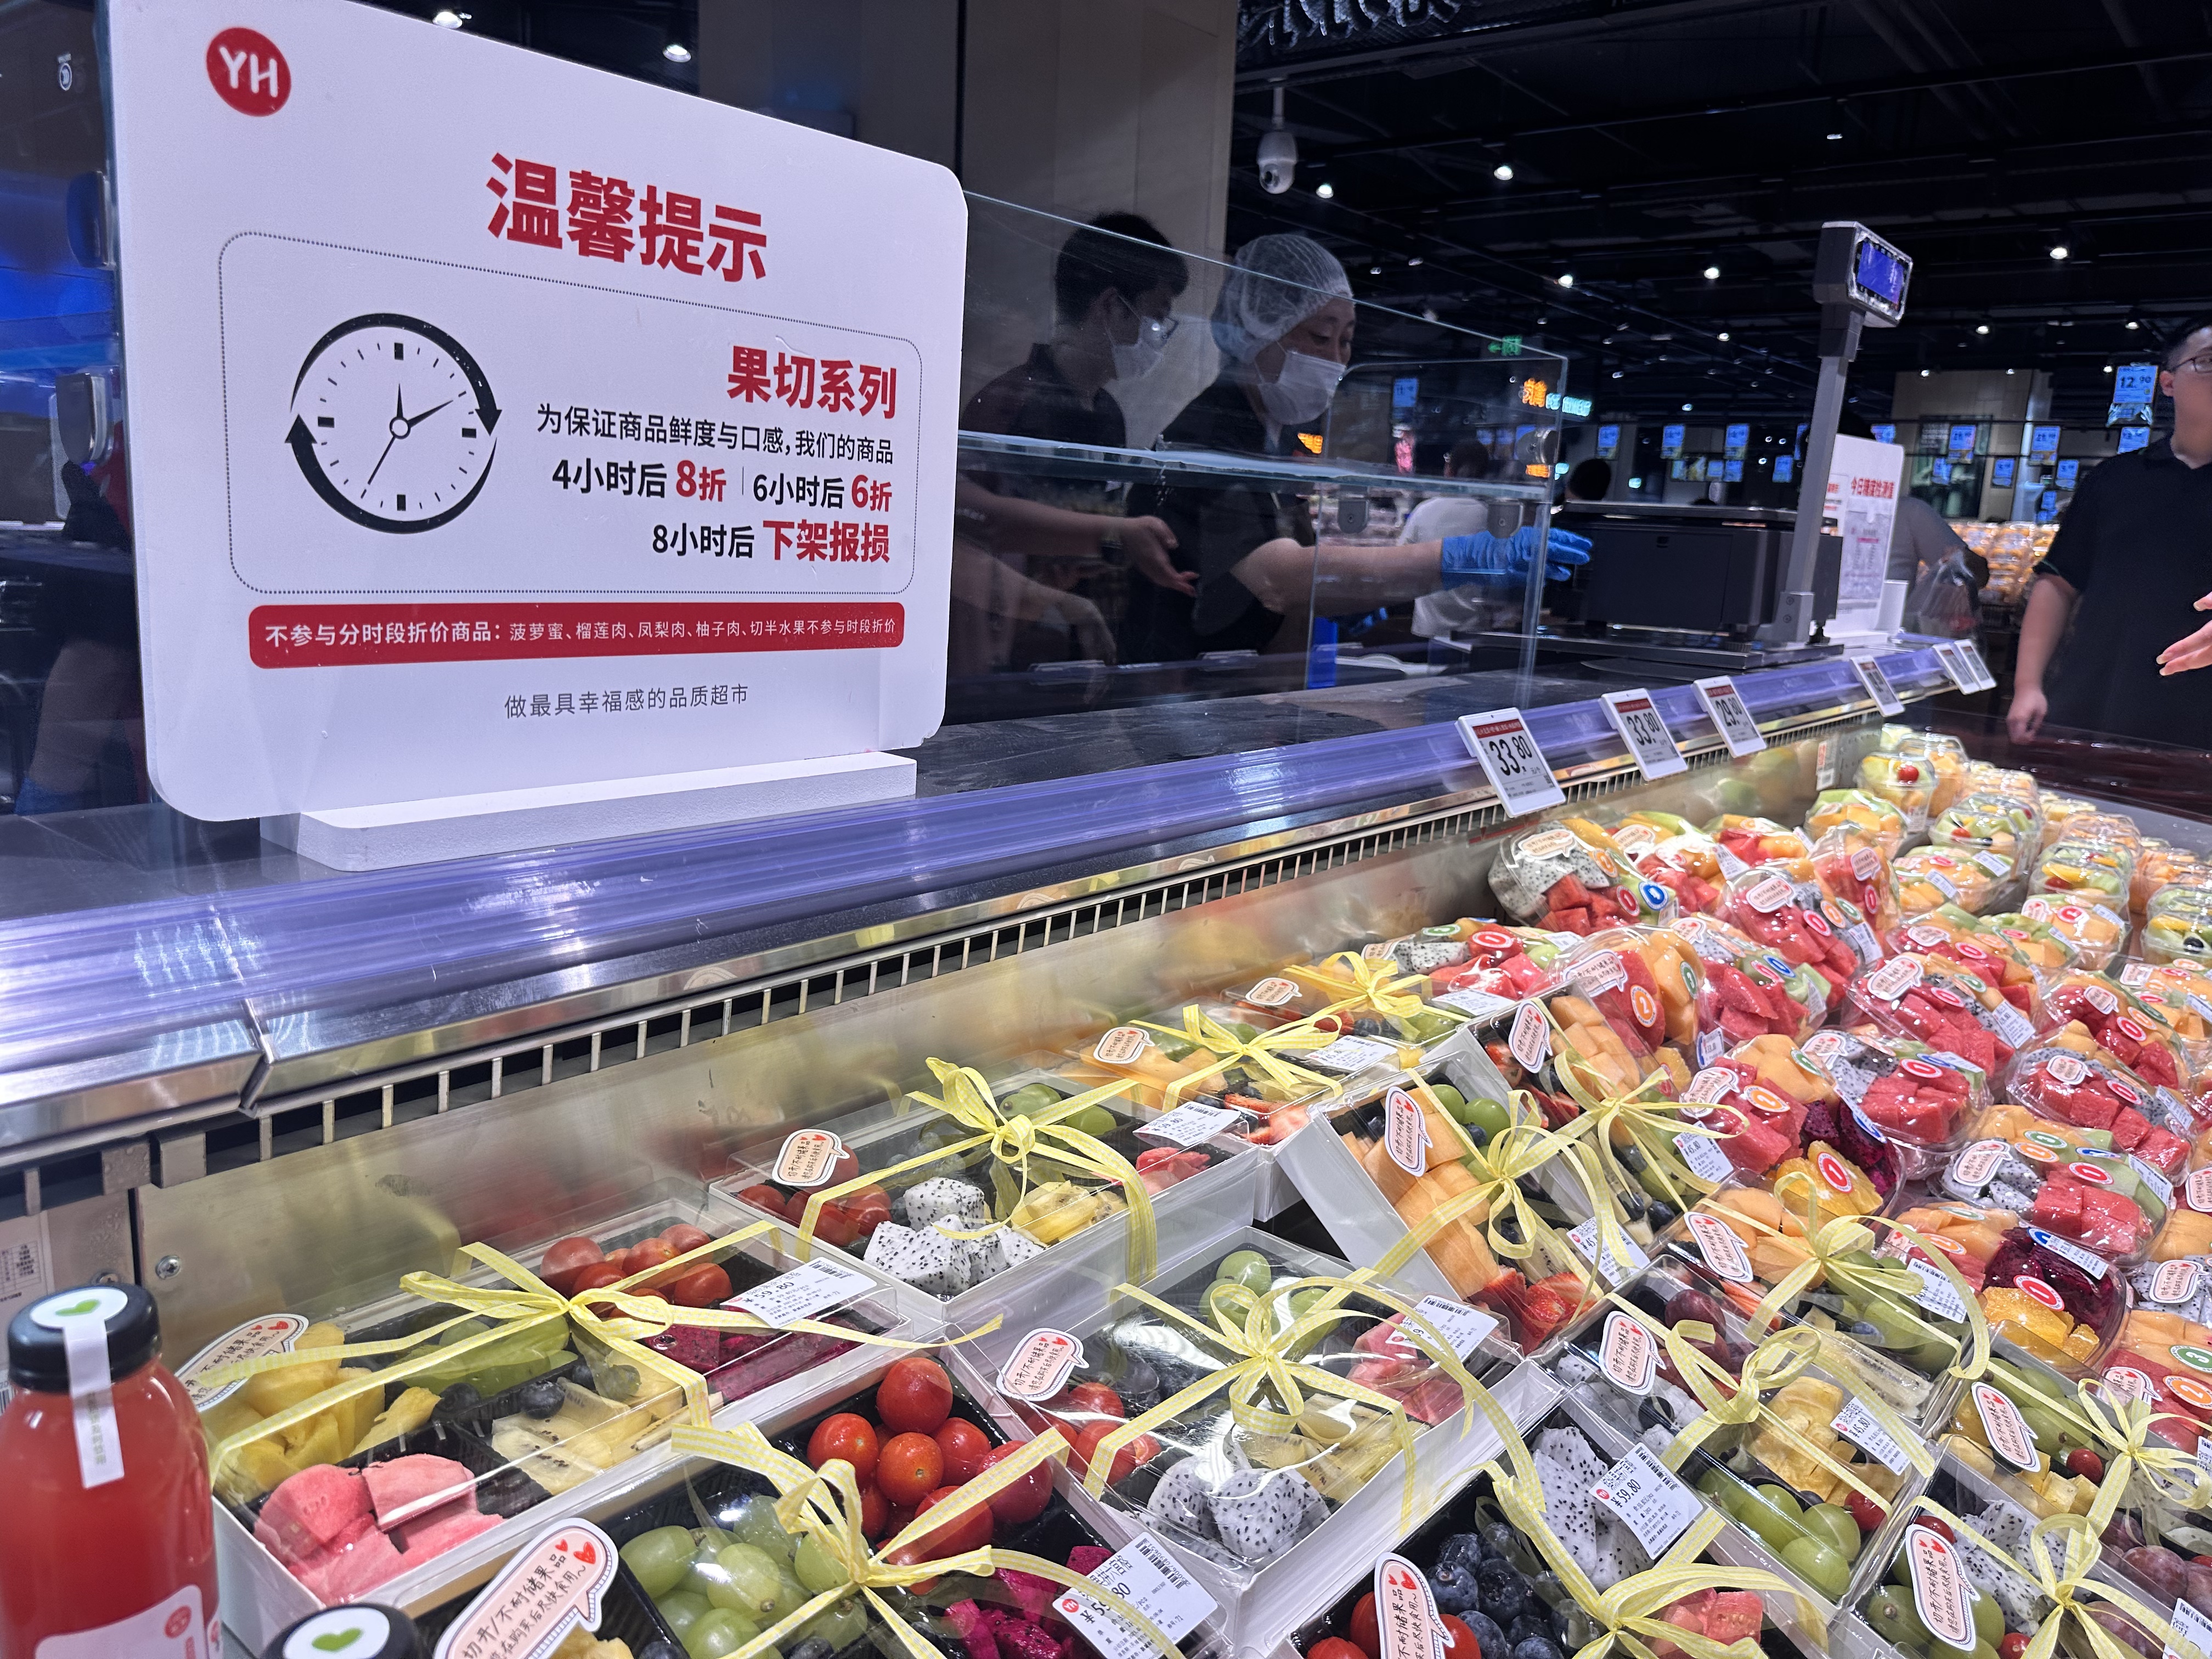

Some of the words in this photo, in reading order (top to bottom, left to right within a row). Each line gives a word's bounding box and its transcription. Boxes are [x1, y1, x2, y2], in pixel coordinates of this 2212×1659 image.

[219, 47, 278, 98] YH
[486, 152, 767, 283] 温馨提示
[728, 345, 897, 420] 果切系列
[552, 458, 667, 499] 4小时后
[675, 459, 727, 503] 8折
[753, 472, 845, 509] 6小时后
[851, 473, 893, 512] 6折
[652, 522, 755, 558] 8小时后
[763, 518, 890, 563] 下架报损
[504, 682, 748, 719] 做最具幸福感的品质超市
[1626, 712, 1660, 746] 33.80
[1488, 735, 1533, 776] 33.80
[1639, 997, 1650, 1014] 2
[1757, 1097, 1776, 1107] 2
[1828, 1164, 1843, 1181] 1
[2083, 1169, 2097, 1177] 1
[742, 1282, 795, 1303] ¥59.80
[2028, 1286, 2050, 1299] 1
[1013, 1342, 1049, 1386] 切开/不耐储果品
[2185, 1351, 2210, 1363] 3
[2180, 1384, 2204, 1398] 2
[1848, 1417, 1871, 1438] ¥45.80
[1610, 1479, 1641, 1508] ¥59.80
[1922, 1549, 1945, 1624] 切开/不耐储果品
[462, 1553, 566, 1659] 切开/不耐储果品
[489, 1565, 586, 1659] 您在购买后尽快食用~
[1063, 1600, 1078, 1611] YH
[1392, 1589, 1410, 1659] 不耐储果品
